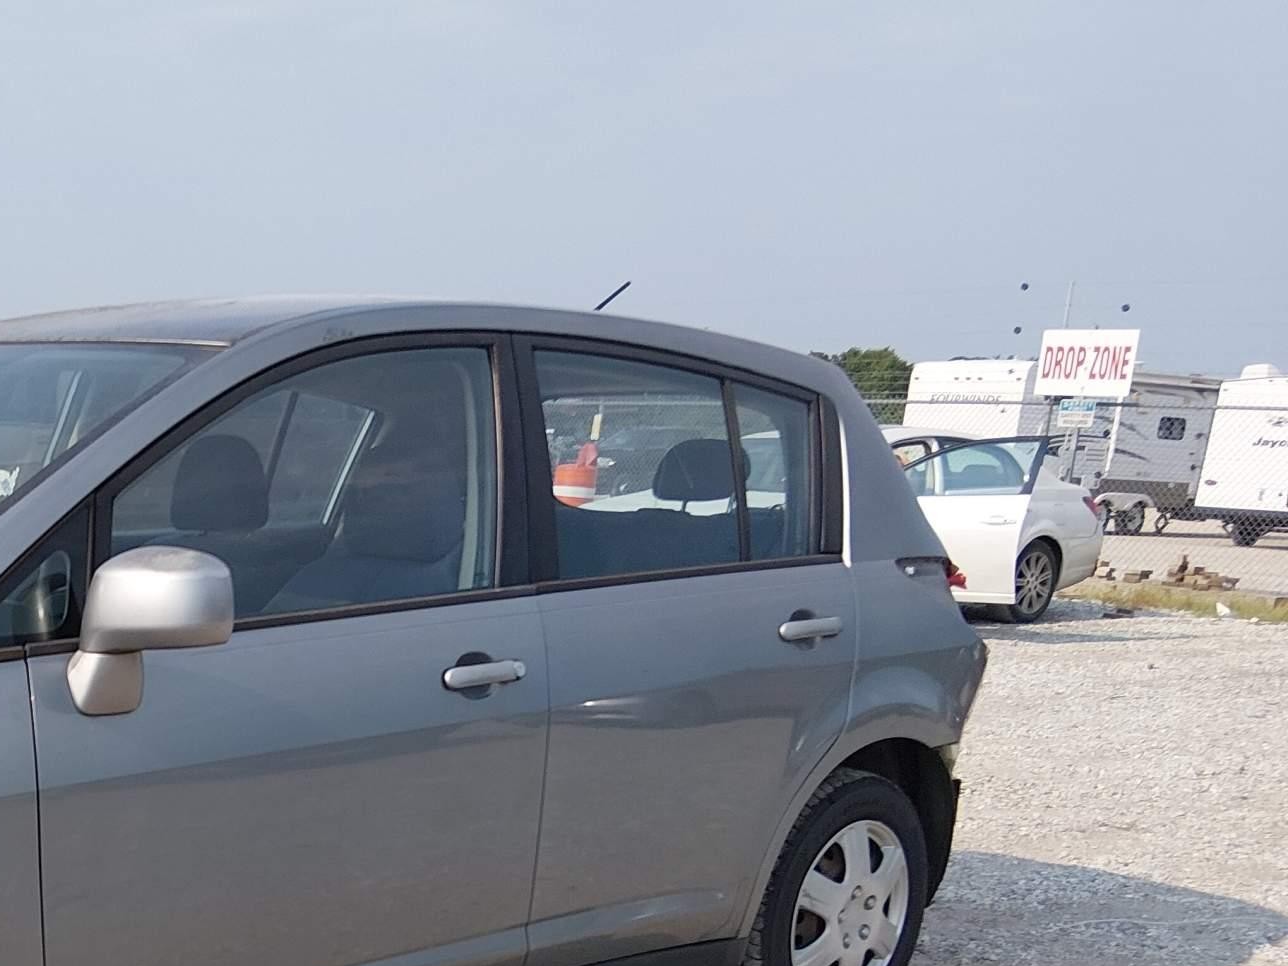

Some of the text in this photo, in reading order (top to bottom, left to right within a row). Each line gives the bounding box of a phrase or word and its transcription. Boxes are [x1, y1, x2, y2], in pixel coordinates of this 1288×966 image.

[1041, 346, 1132, 380] DROP ZONE
[1252, 436, 1288, 448] Jayc
